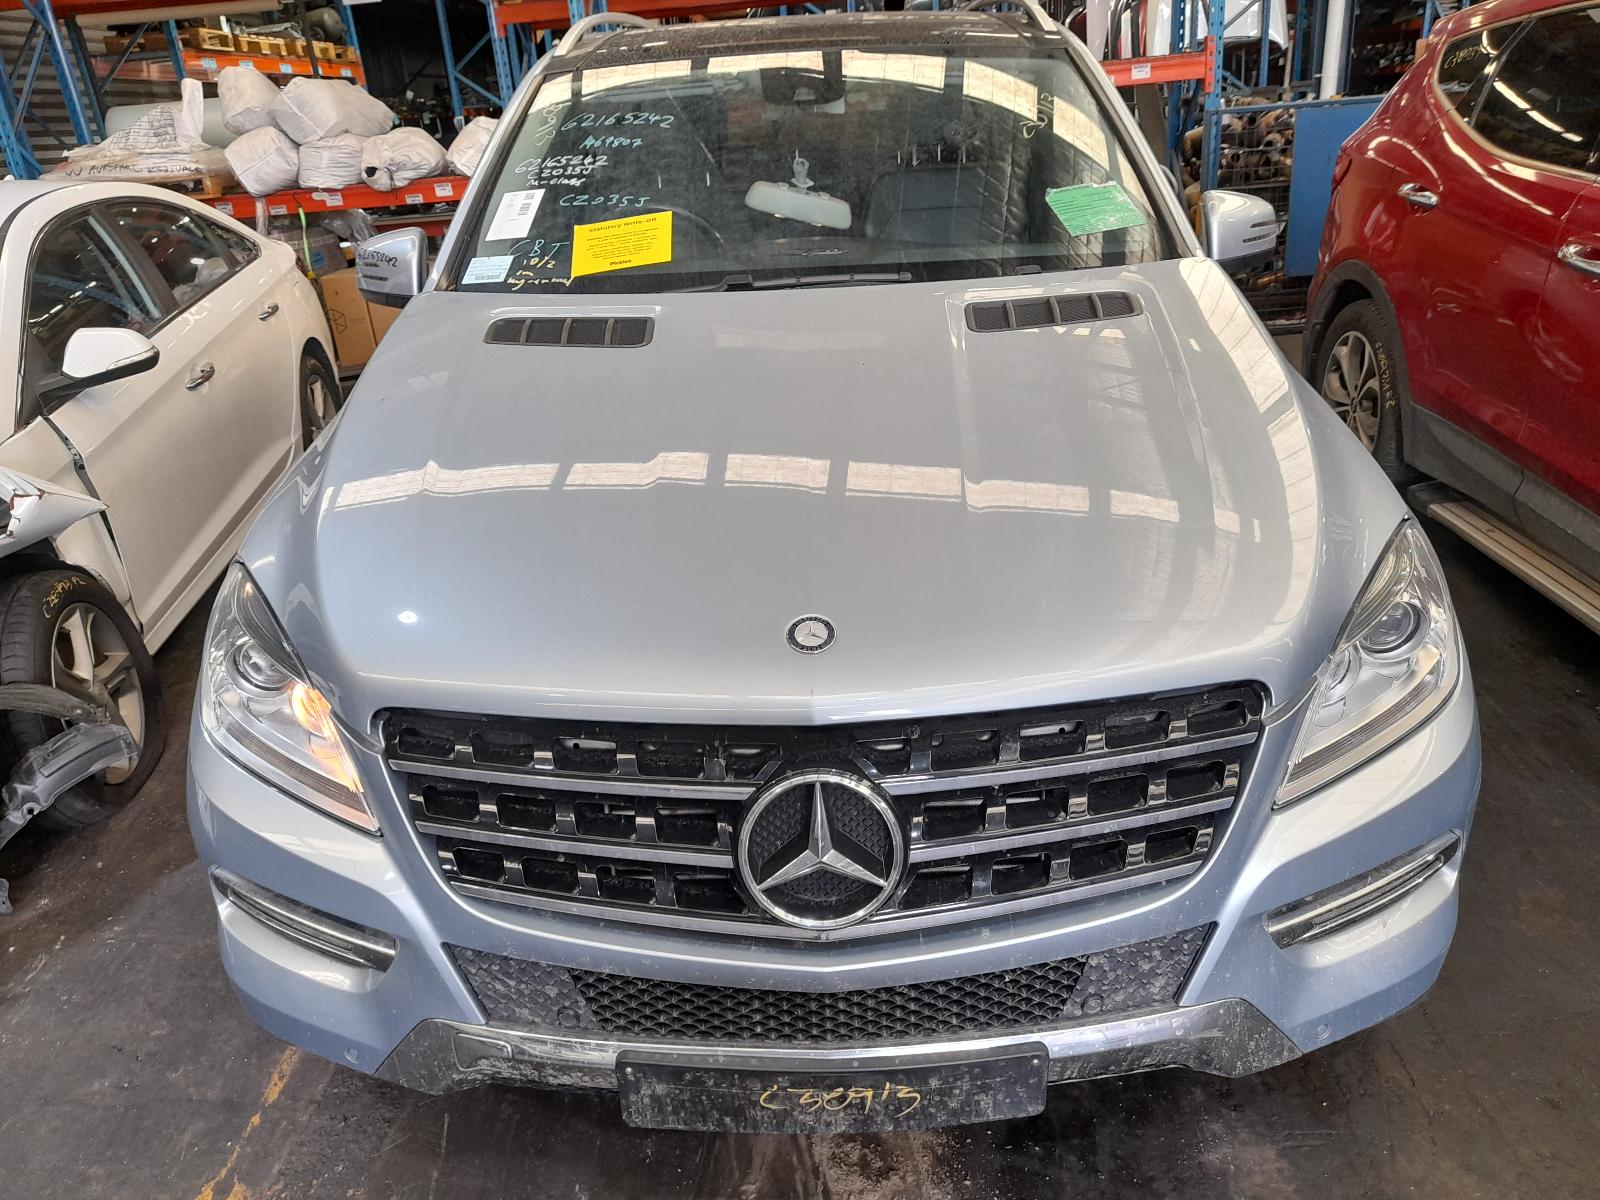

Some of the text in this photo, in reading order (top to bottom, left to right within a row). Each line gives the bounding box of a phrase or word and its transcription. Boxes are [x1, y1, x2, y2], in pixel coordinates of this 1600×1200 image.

[561, 112, 675, 131] 62165242
[515, 155, 608, 174] 62165242
[560, 194, 651, 208] CZ035J
